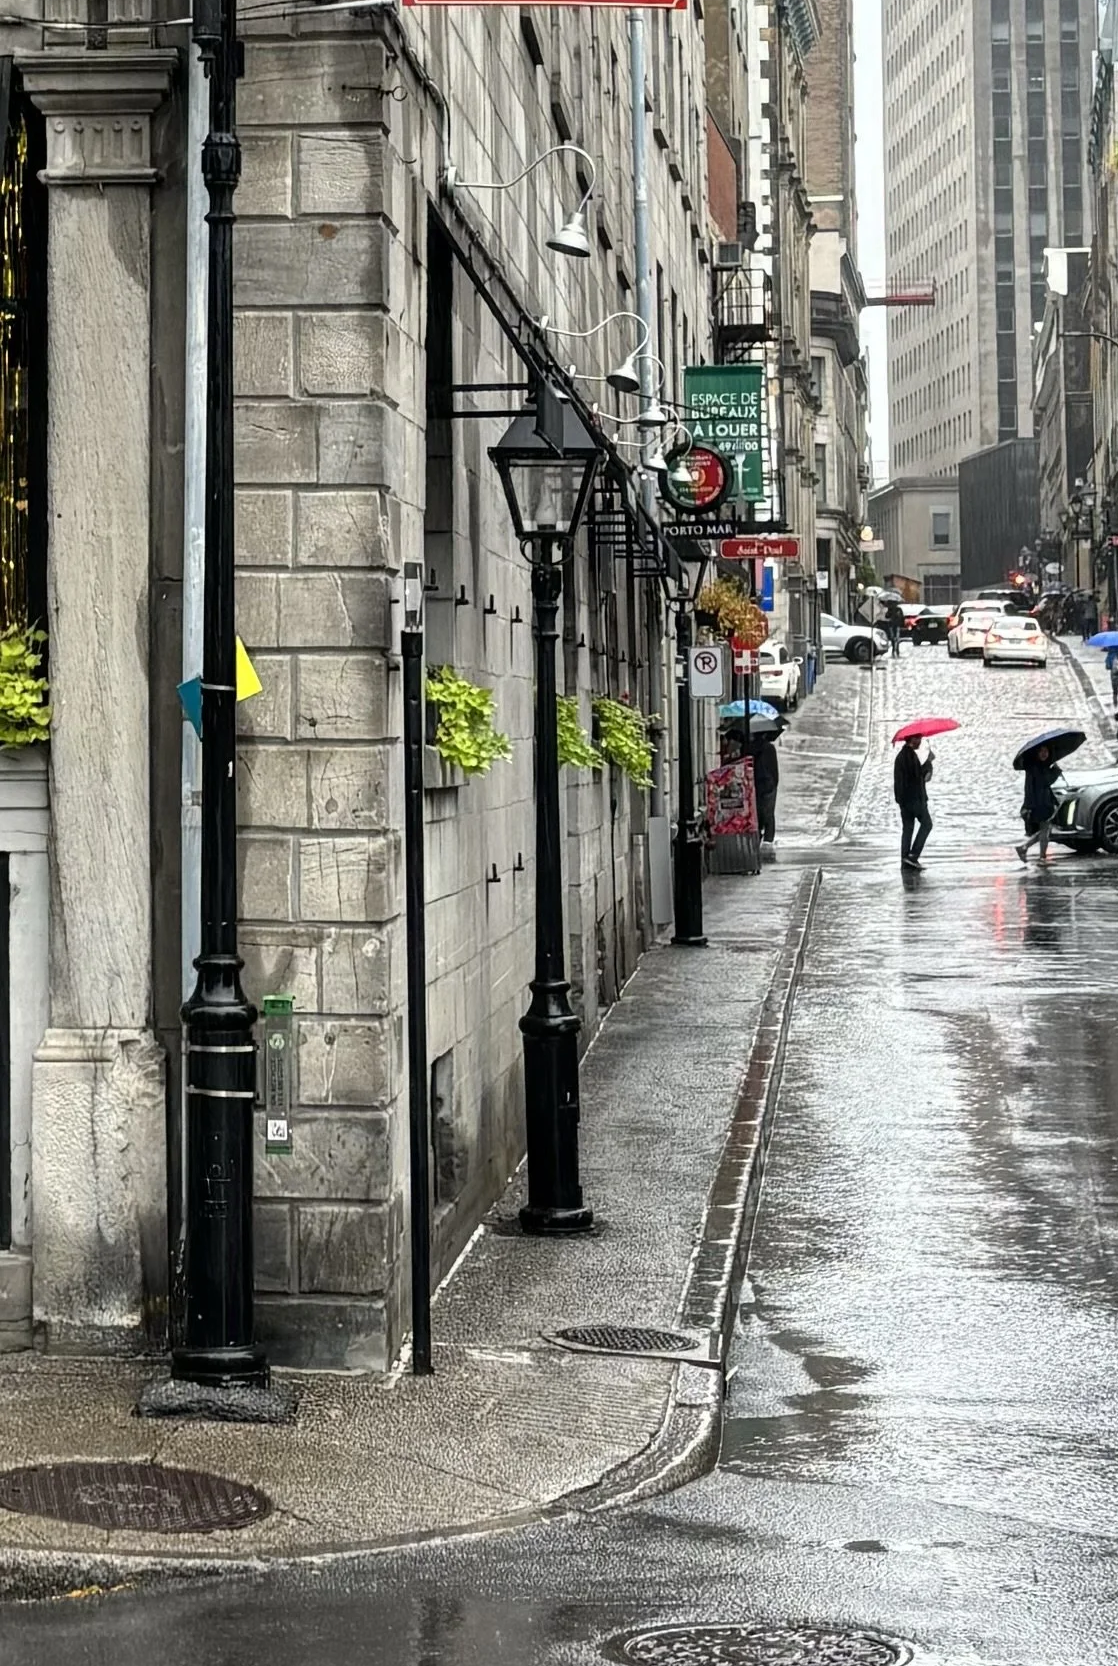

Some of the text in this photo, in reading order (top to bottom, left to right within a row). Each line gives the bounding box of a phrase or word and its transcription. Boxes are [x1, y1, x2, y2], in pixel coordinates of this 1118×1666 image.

[691, 392, 759, 406] ESPACE DE
[693, 420, 759, 438] À LOUER
[663, 523, 733, 537] PORTO MAR
